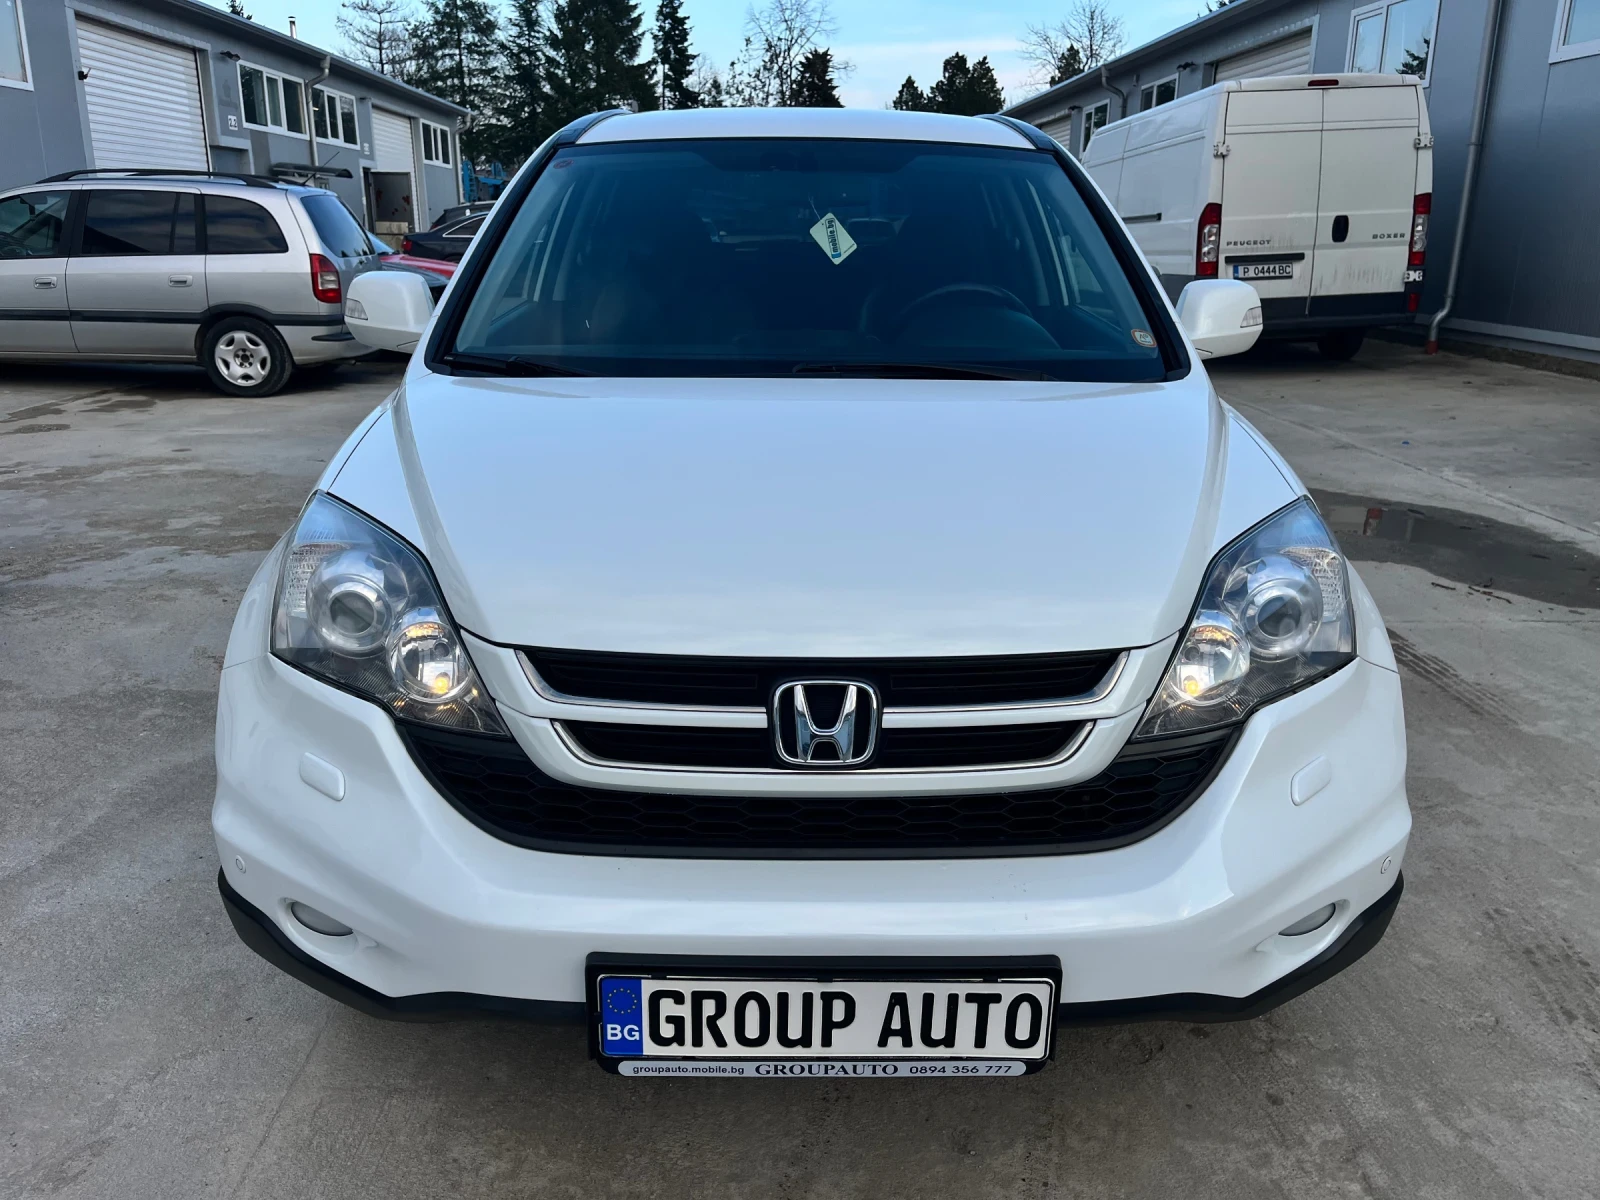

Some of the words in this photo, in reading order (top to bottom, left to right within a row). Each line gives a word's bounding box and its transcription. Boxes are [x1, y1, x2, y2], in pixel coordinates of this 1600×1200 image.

[827, 219, 839, 253] mobile.bg
[1243, 267, 1249, 276] P
[648, 989, 856, 1048] GROUP
[877, 992, 1043, 1049] AUTO
[606, 1024, 640, 1041] BG
[632, 1065, 744, 1075] groupauto.mobile.bg
[755, 1064, 899, 1075] GROUPAUTO
[909, 1065, 946, 1074] 0894
[952, 1065, 979, 1074] 356
[985, 1065, 1012, 1074] 777
